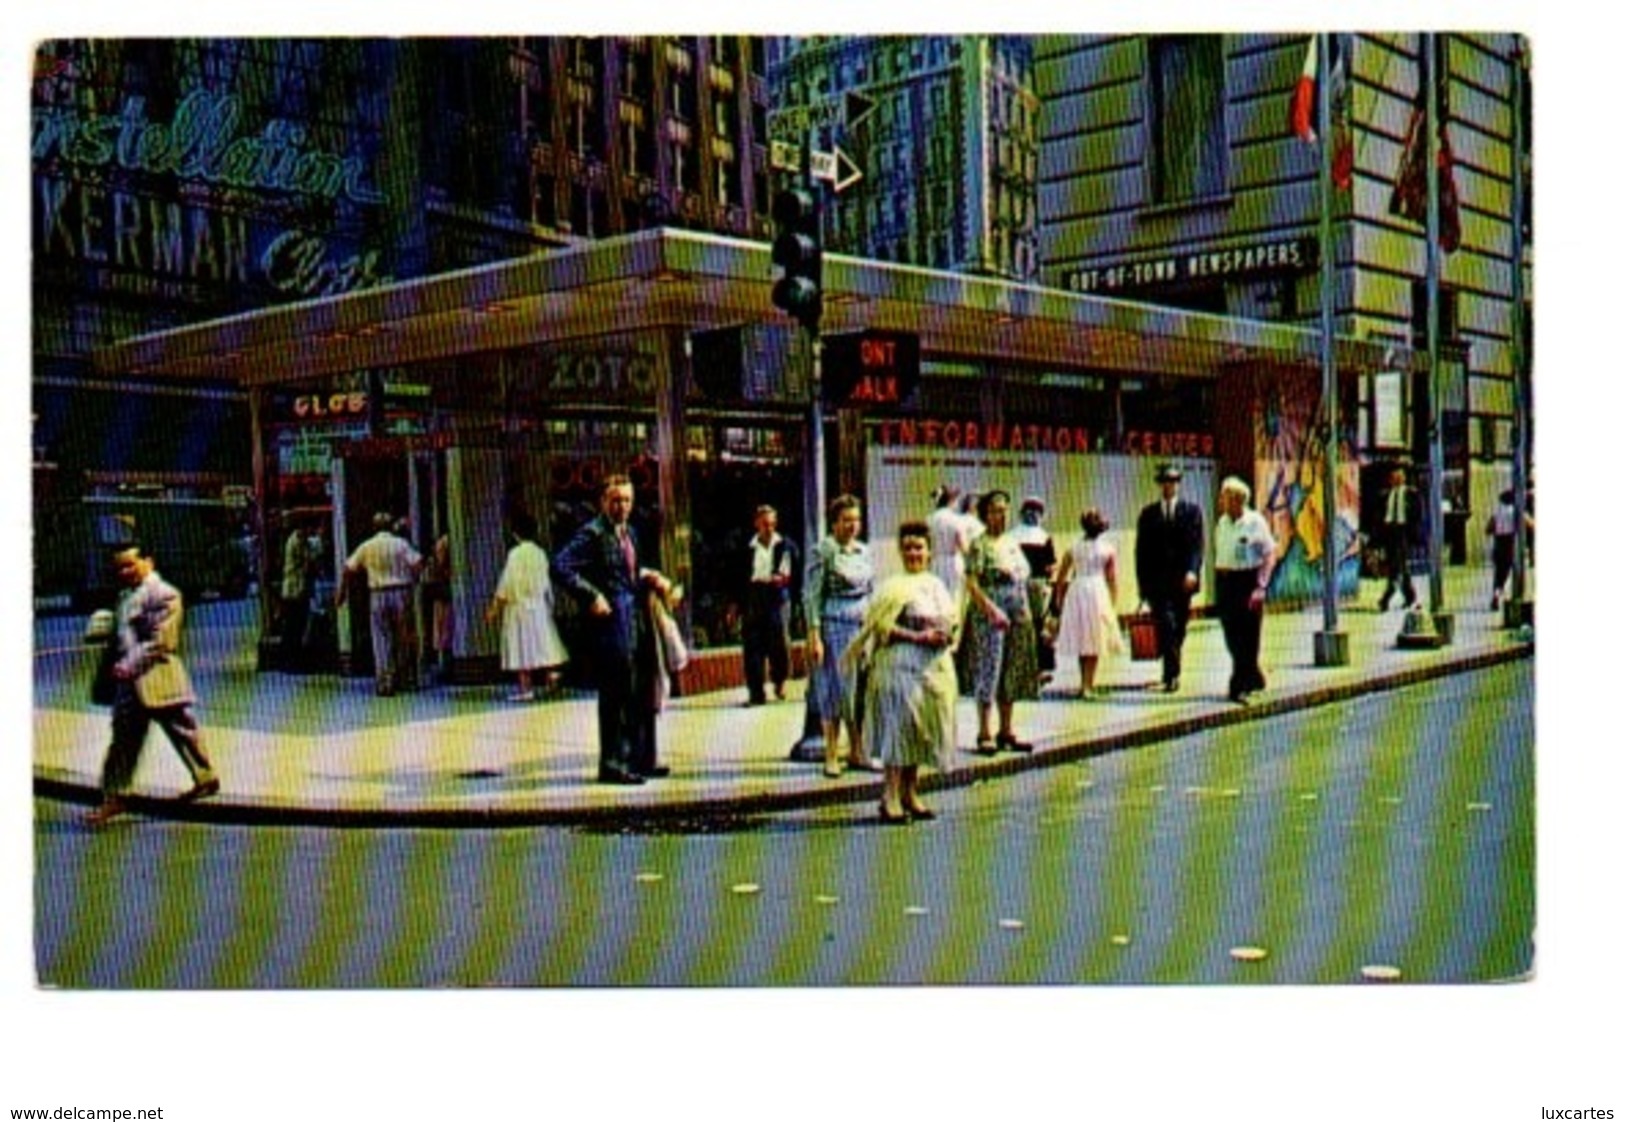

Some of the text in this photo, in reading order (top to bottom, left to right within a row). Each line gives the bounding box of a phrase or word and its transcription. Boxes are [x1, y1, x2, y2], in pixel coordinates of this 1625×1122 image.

[1070, 242, 1301, 291] OUT-OF-TOWN NEWSPAPERS
[861, 340, 896, 365] ONT
[855, 376, 899, 401] ALK
[881, 419, 1214, 456] INFORMATION CENTER
